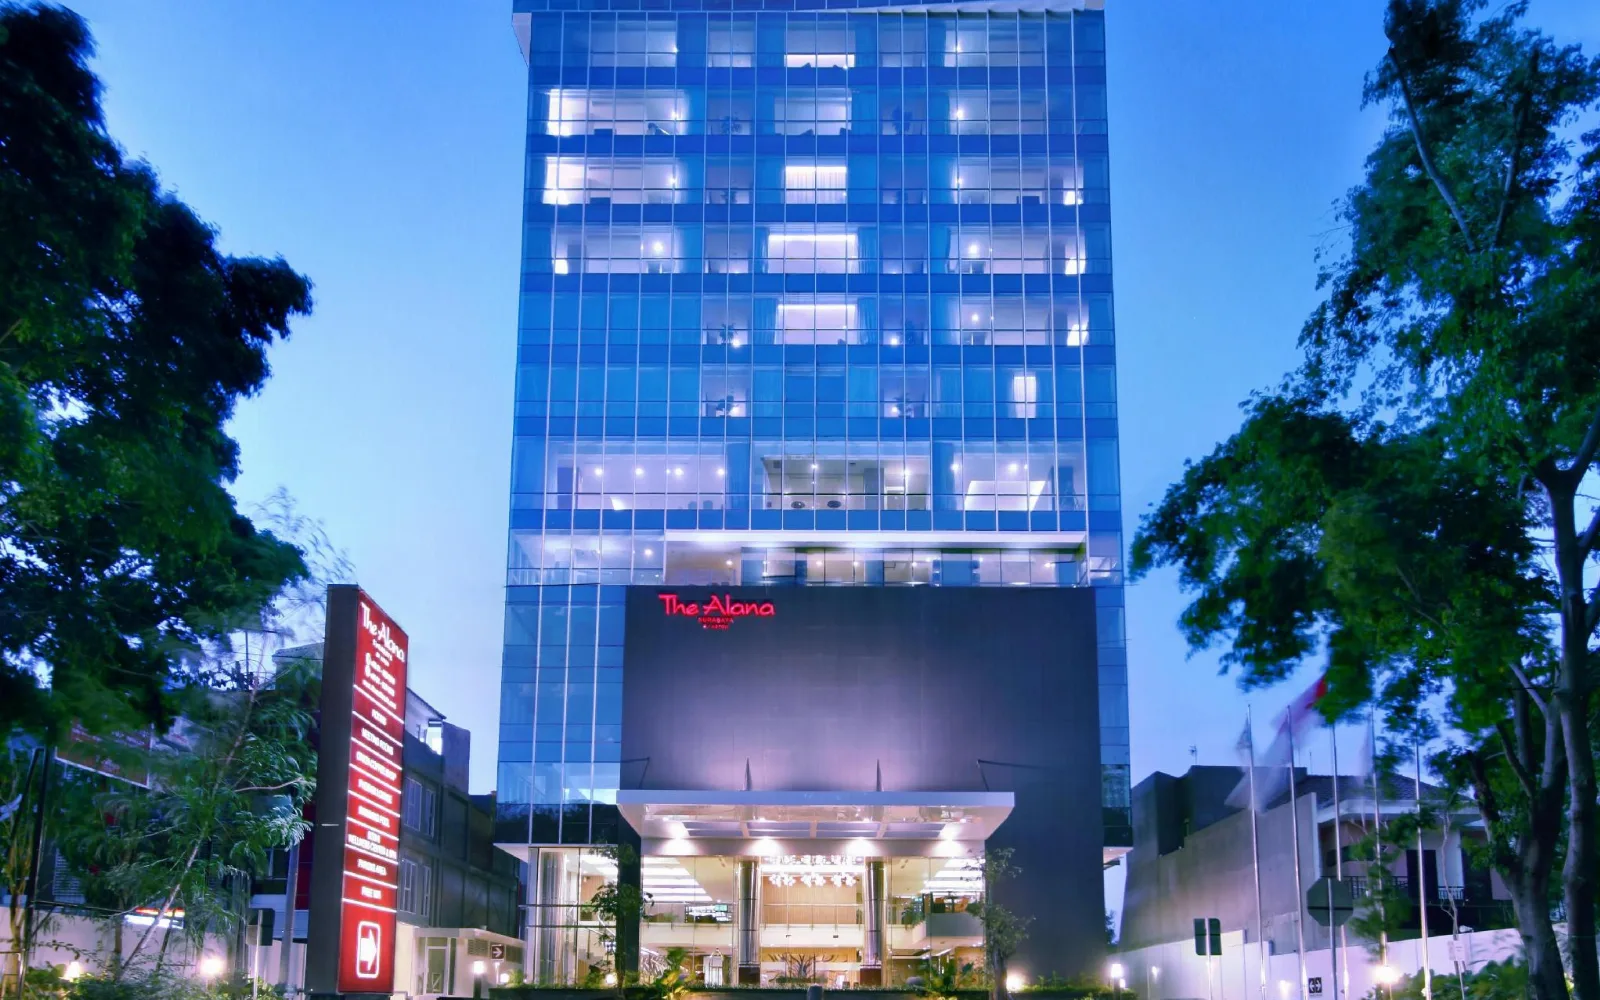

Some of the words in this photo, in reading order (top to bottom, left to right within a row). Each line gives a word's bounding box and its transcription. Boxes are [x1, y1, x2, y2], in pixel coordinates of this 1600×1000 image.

[658, 594, 699, 616] The
[703, 594, 775, 616] Alana
[360, 601, 377, 637] The
[377, 621, 405, 663] Alana
